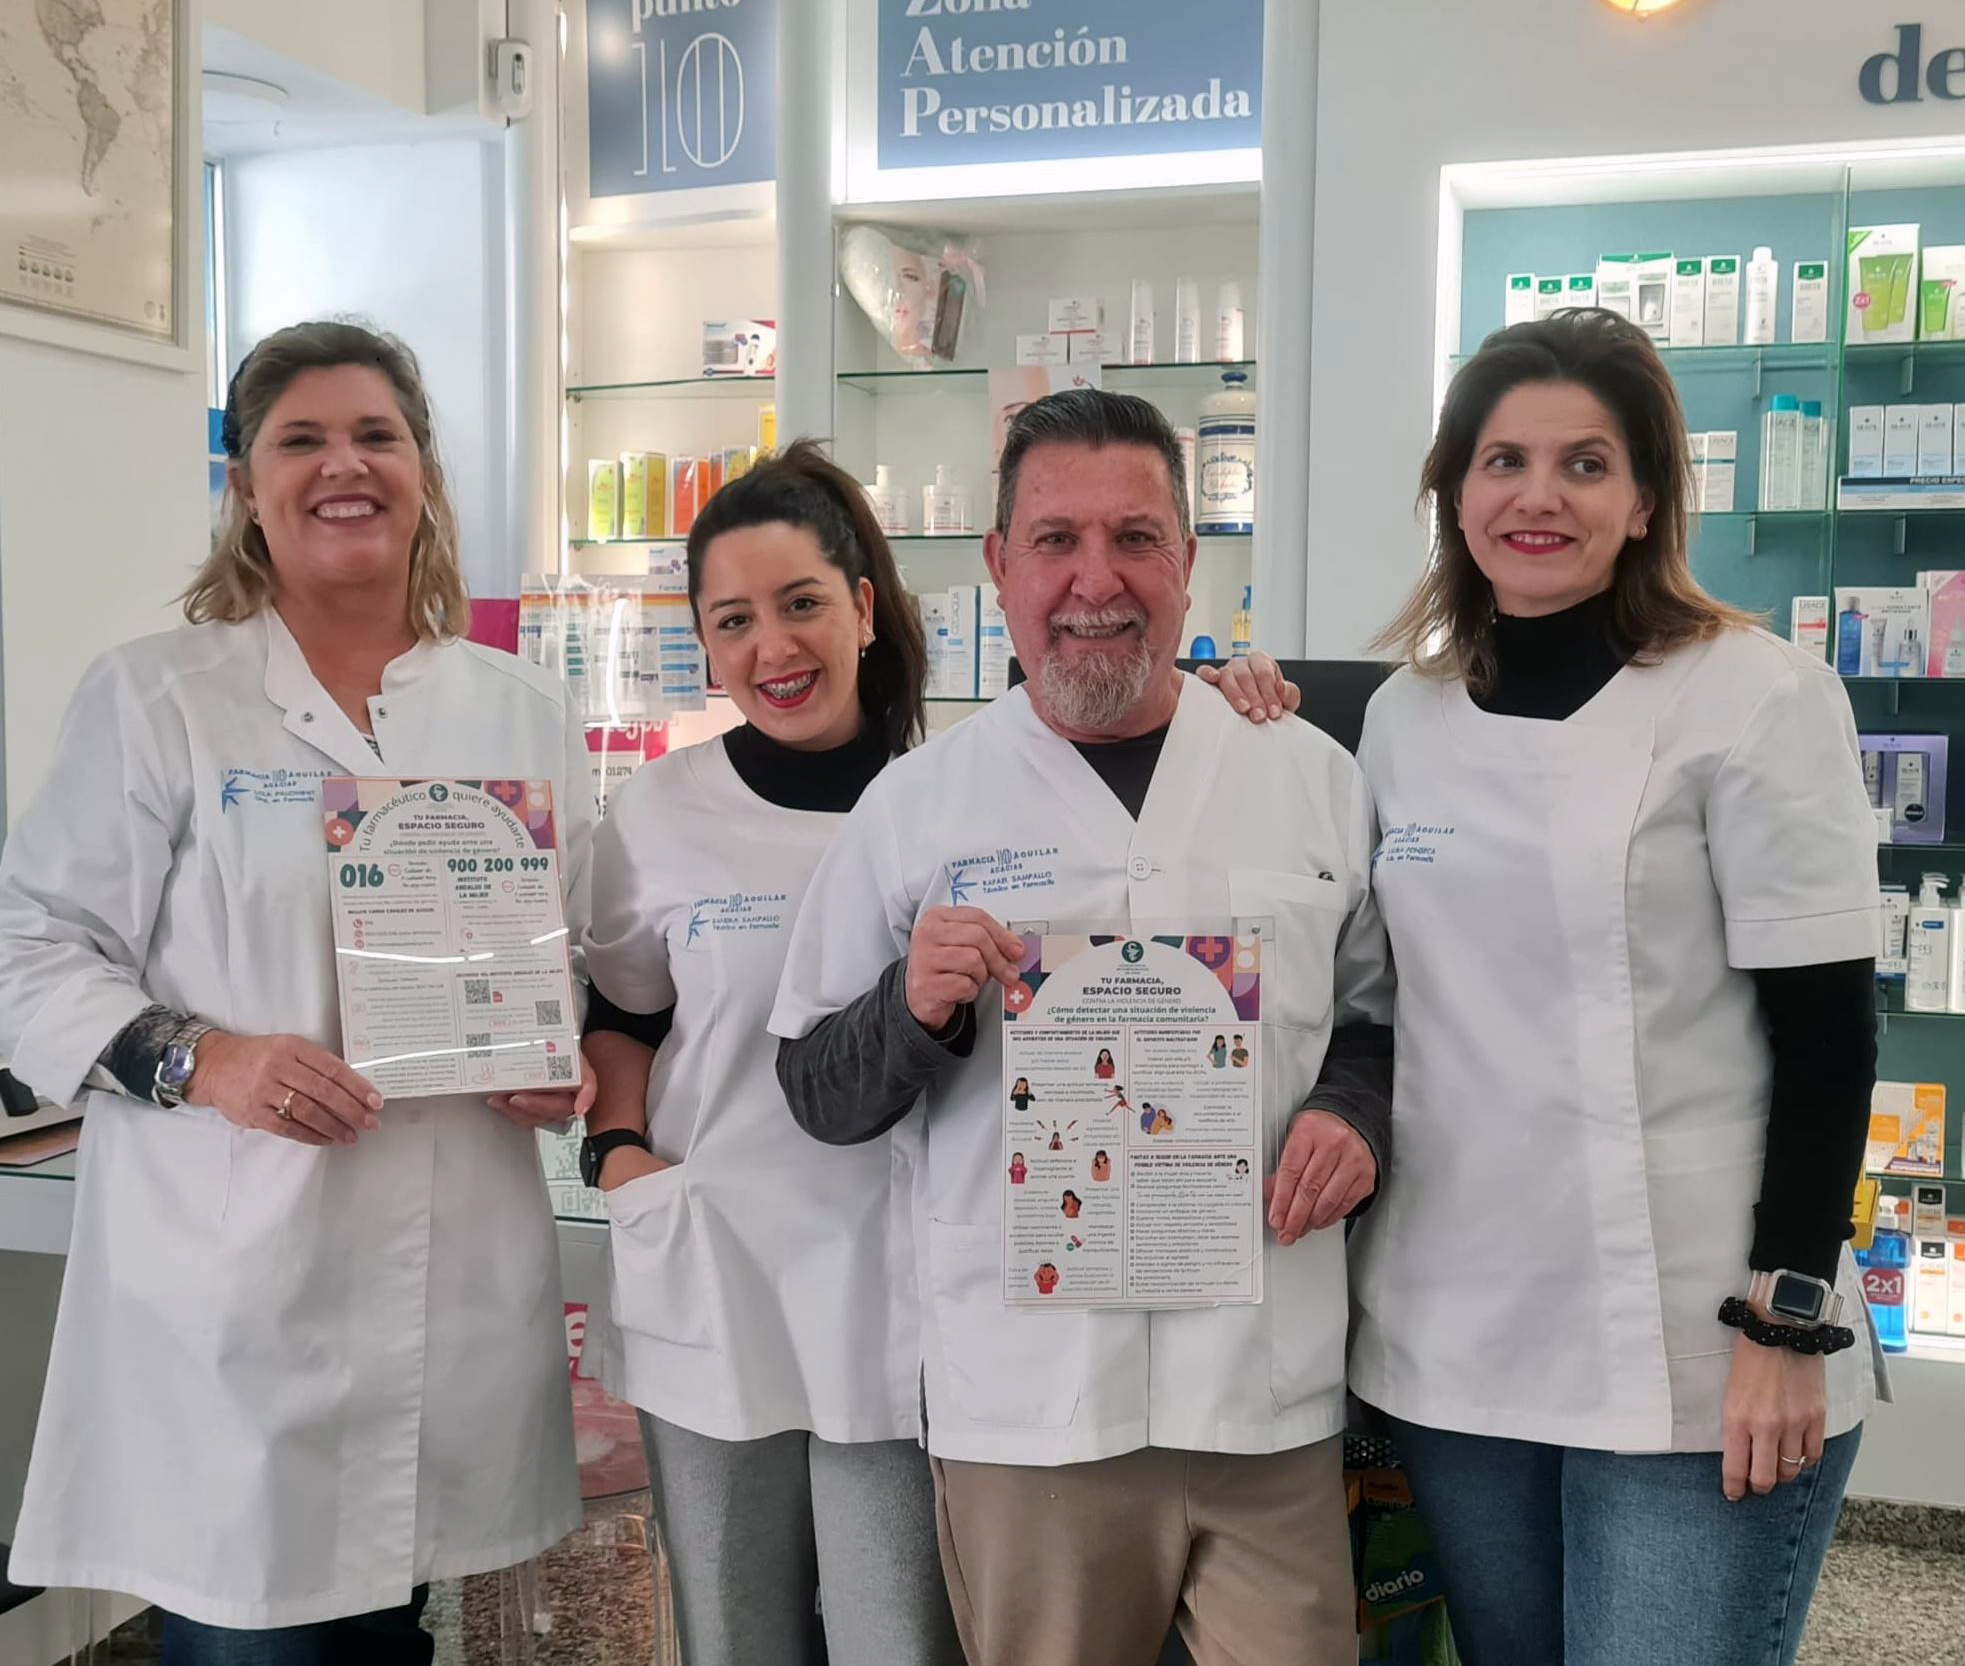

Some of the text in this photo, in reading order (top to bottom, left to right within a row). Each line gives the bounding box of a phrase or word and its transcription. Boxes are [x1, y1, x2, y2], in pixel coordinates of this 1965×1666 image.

[900, 25, 1128, 77] Atención
[1858, 23, 1965, 105] de
[900, 78, 1253, 137] Personalizada
[359, 790, 525, 852] Tu farmacéutico quiere ayudarte
[398, 822, 442, 830] ESPACIO
[1416, 826, 1455, 835] AGUILAR
[447, 857, 549, 873] 900 200 999
[952, 855, 996, 869] FARMACIA
[1013, 847, 1059, 860] AGUILAR
[339, 863, 385, 888] 016
[744, 894, 786, 903] AGUILAR
[1114, 977, 1164, 985] FARMACIA,
[1082, 987, 1181, 995] ESPACIO SEGURO
[1047, 1006, 1075, 1015] ¿Cómo
[1077, 1006, 1110, 1014] detectar
[1130, 1006, 1167, 1014] situación
[1168, 1006, 1179, 1014] de
[1180, 1006, 1216, 1014] violencia
[1054, 1015, 1065, 1023] de
[1066, 1014, 1095, 1025] género
[1108, 1015, 1117, 1023] la
[1118, 1015, 1153, 1023] farmacia
[1155, 1015, 1209, 1023] comunitaria?
[1867, 1274, 1902, 1295] 2x1
[1365, 1569, 1426, 1603] diario
